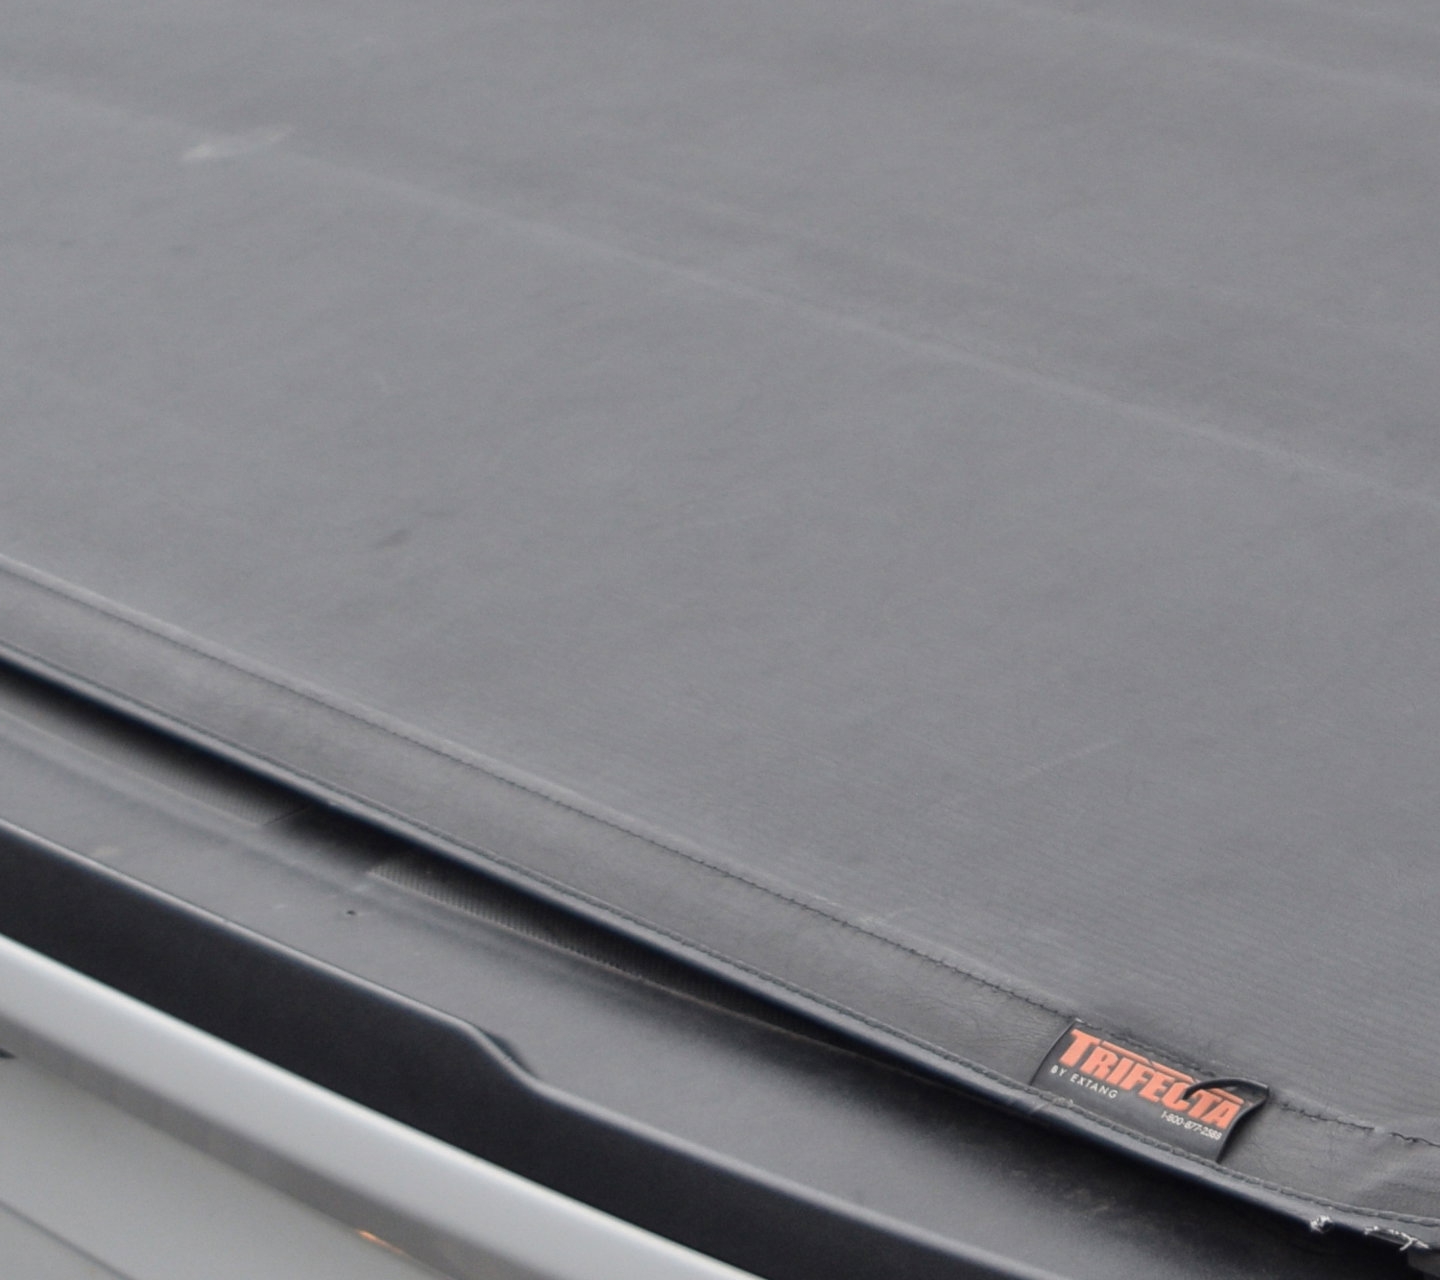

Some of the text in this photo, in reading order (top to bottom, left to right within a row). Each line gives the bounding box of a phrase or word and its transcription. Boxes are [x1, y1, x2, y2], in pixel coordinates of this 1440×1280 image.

[1050, 1065, 1118, 1099] BY EXTANG
[1059, 1028, 1246, 1129] TRIFECTA
